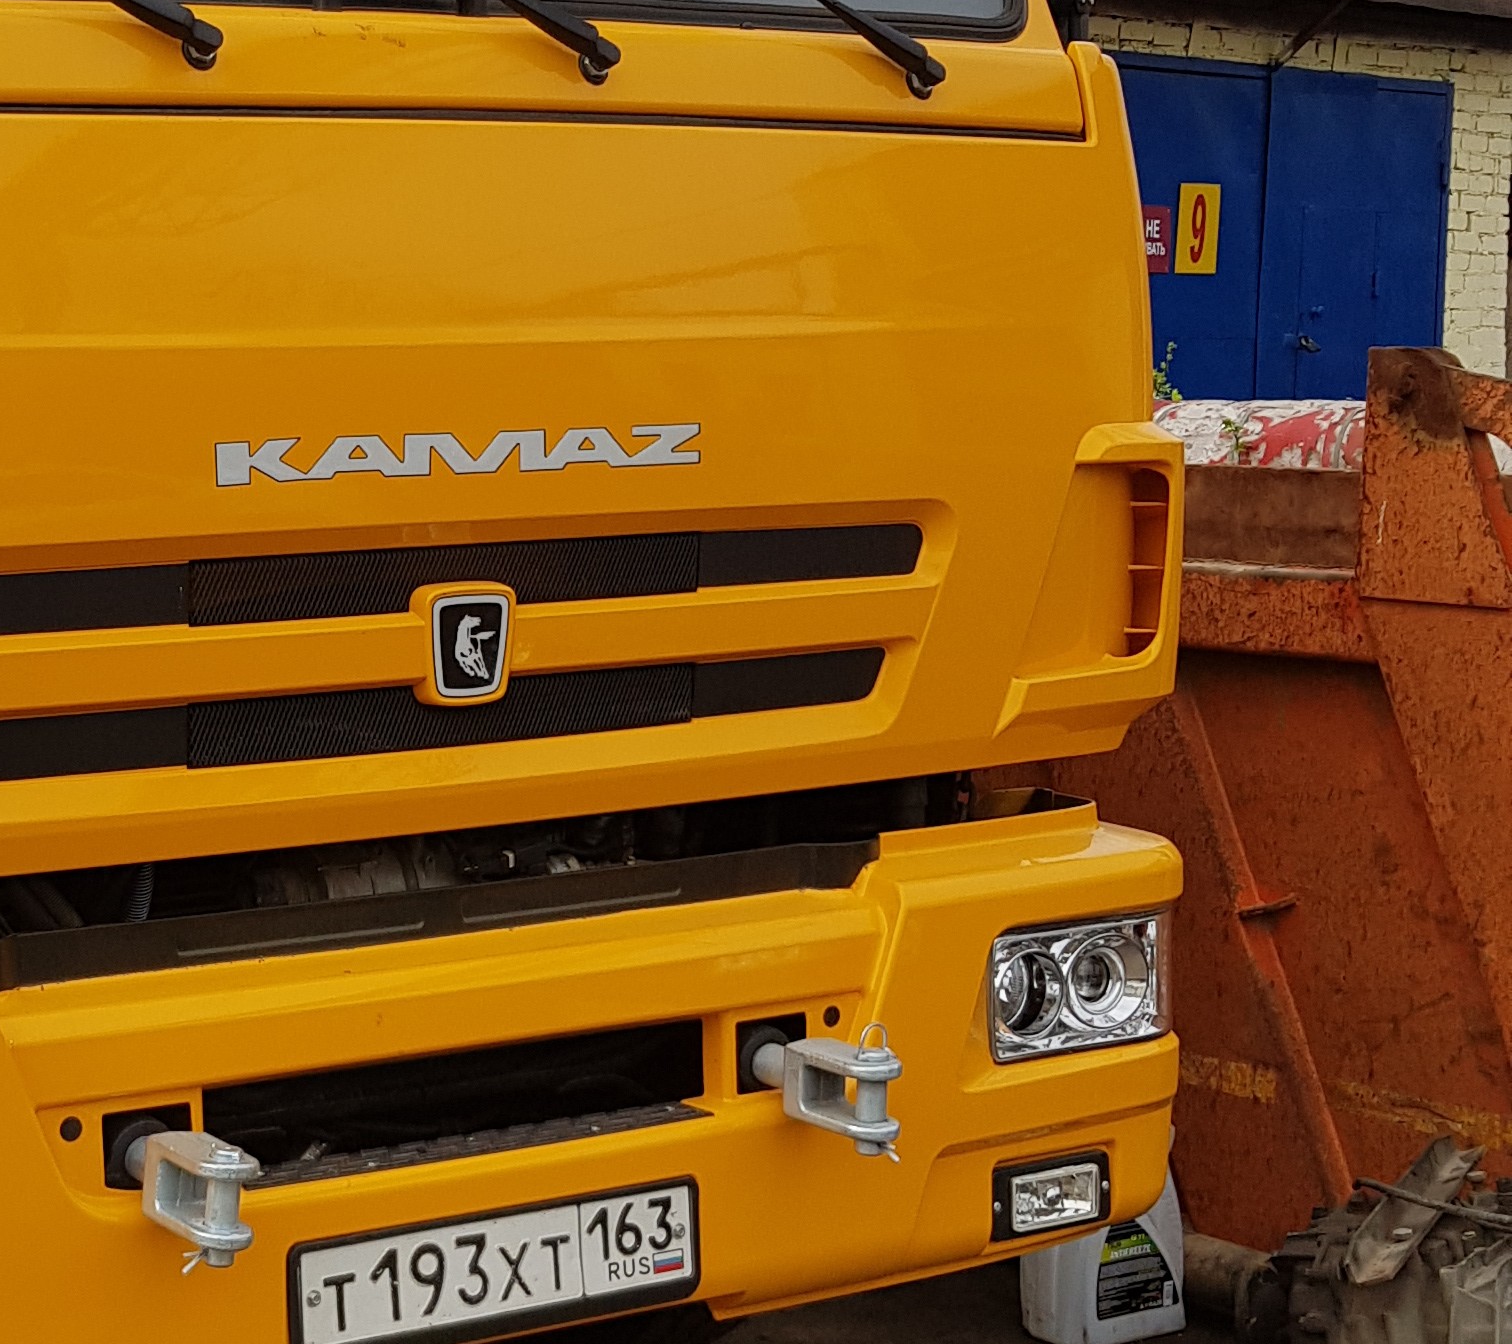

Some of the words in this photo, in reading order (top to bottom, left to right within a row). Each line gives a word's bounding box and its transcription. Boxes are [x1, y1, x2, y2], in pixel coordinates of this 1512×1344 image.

[1145, 219, 1161, 239] НЕ
[1145, 241, 1166, 256] ВАТЬ
[1190, 193, 1207, 264] 9
[215, 423, 701, 487] KAMAZ
[586, 1196, 672, 1261] 163
[607, 1256, 651, 1282] RUS
